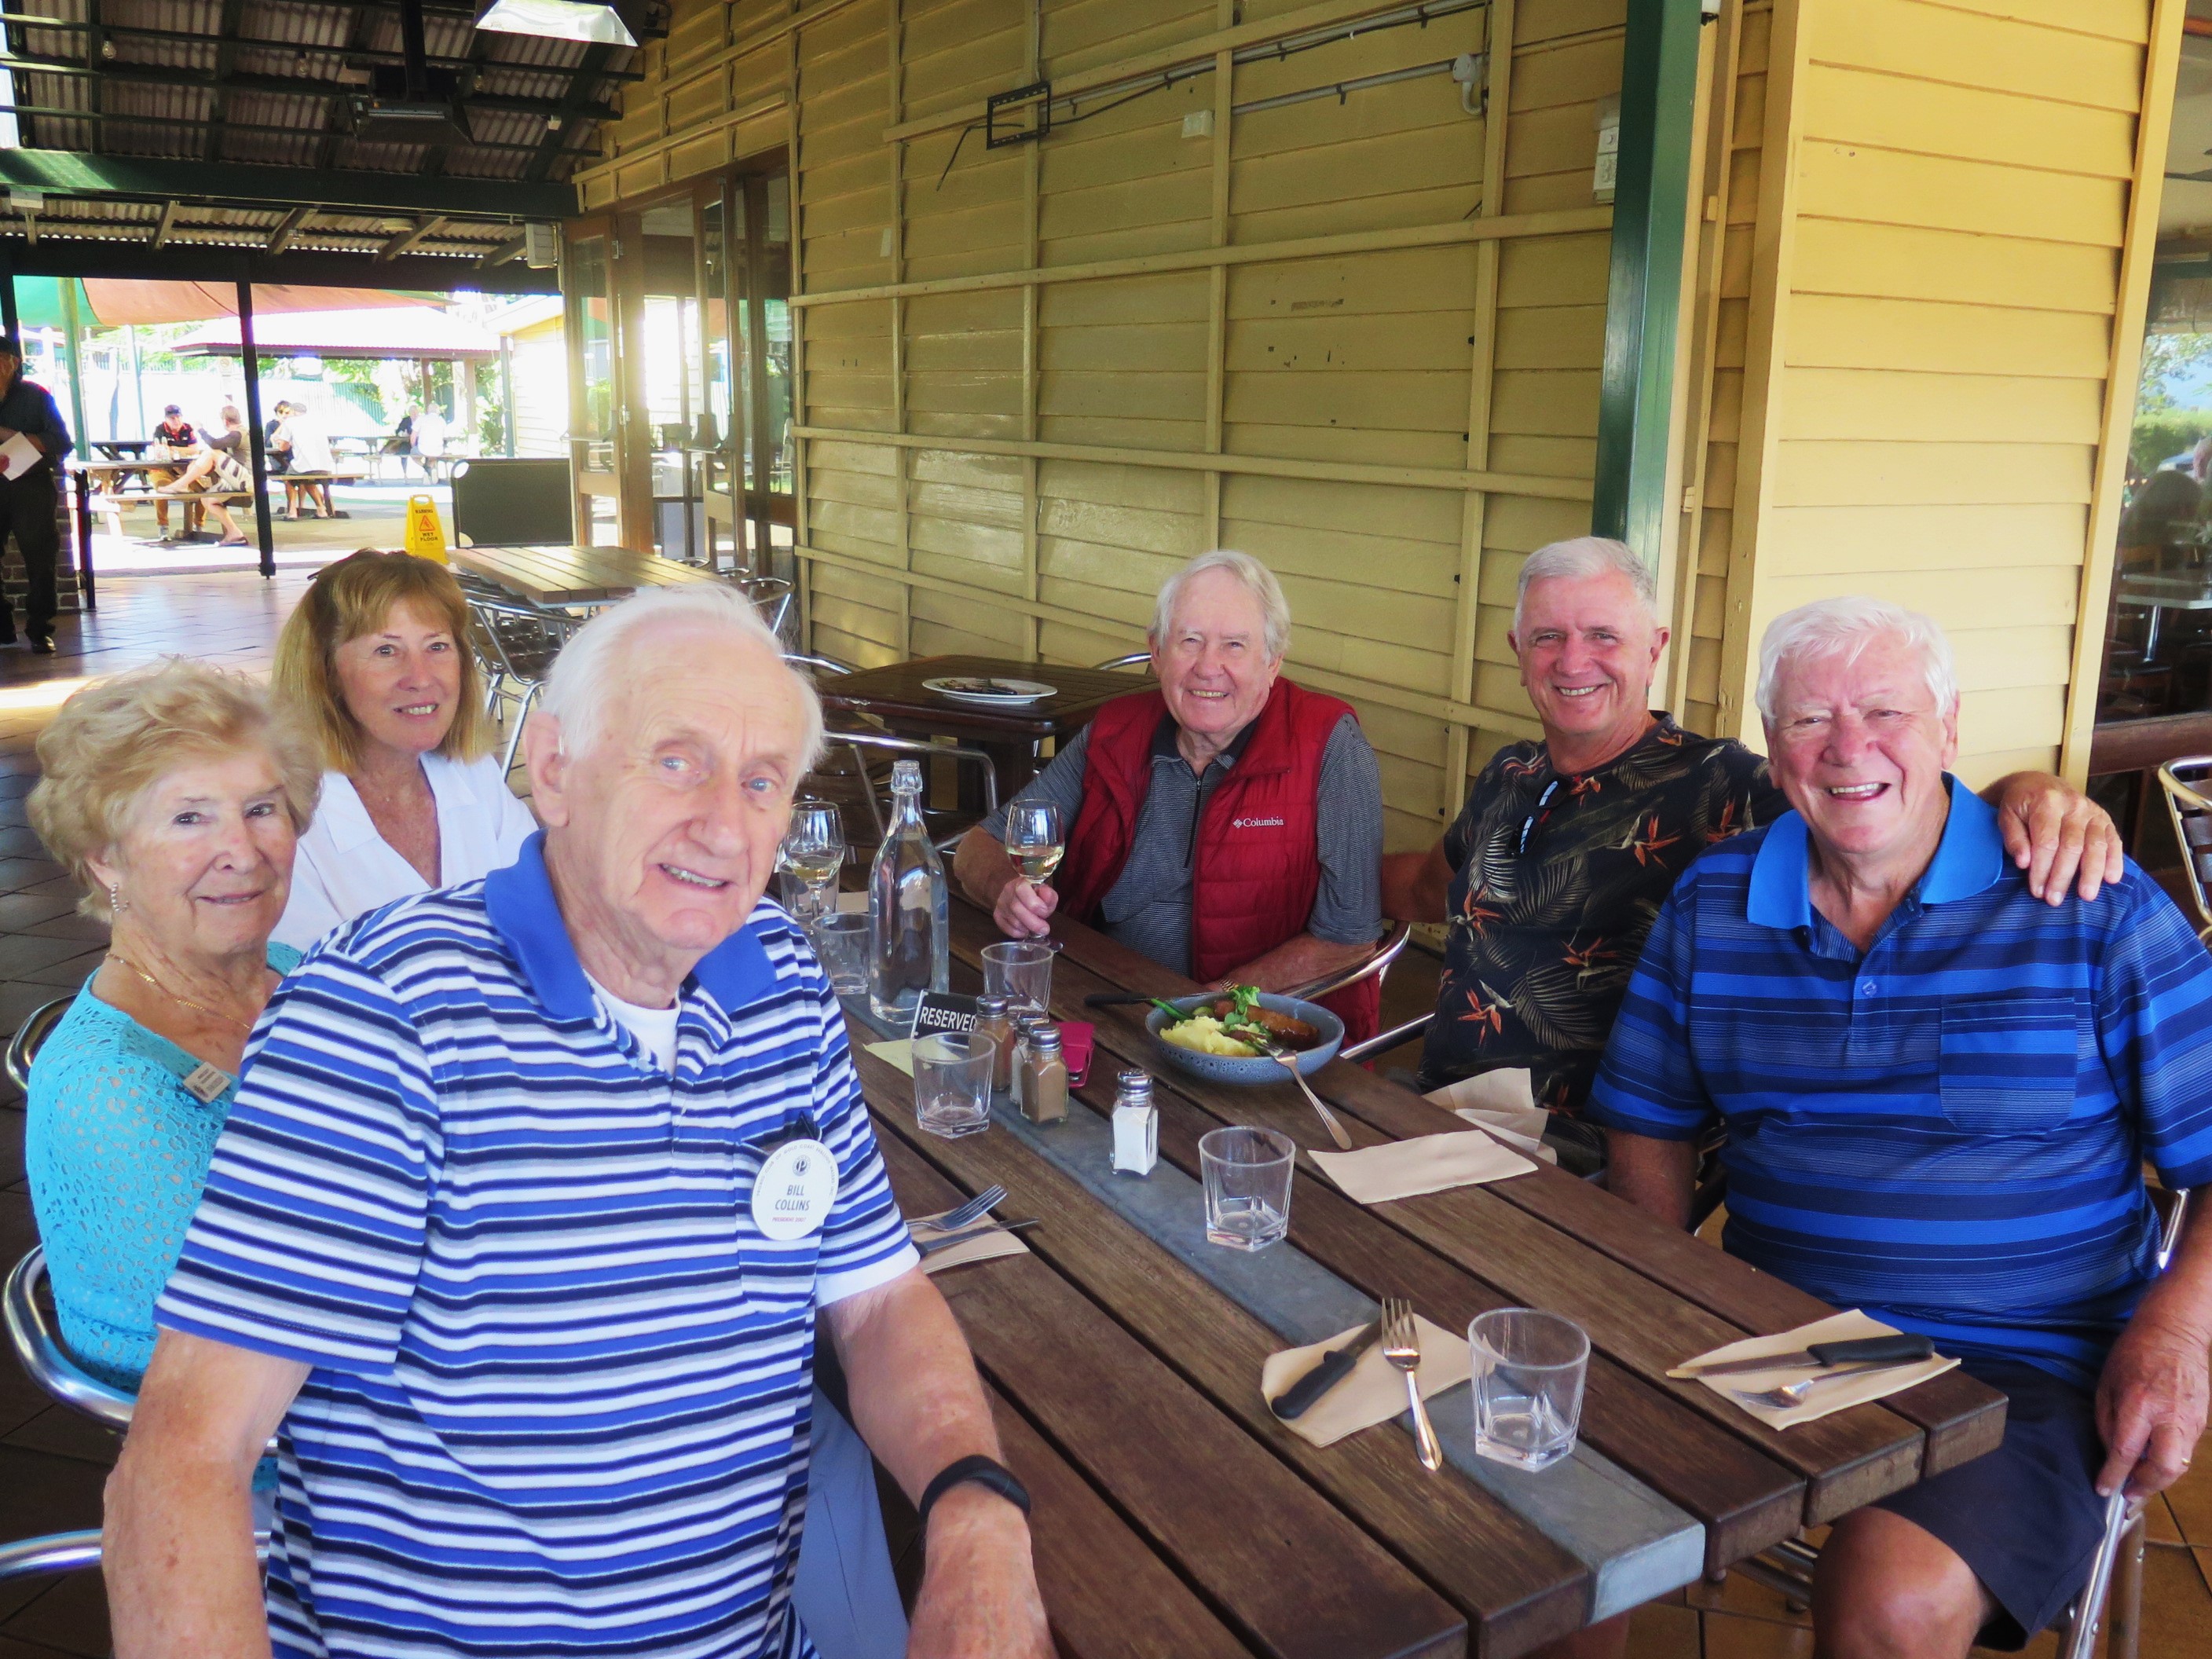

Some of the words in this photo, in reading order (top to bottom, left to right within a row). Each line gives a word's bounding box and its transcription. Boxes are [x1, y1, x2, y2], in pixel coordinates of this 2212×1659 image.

[1243, 816, 1284, 827] Columbia
[919, 1005, 976, 1032] RESERVED
[784, 1144, 797, 1154] GOLD
[787, 1185, 804, 1196] BILL
[775, 1199, 811, 1211] COLLINS
